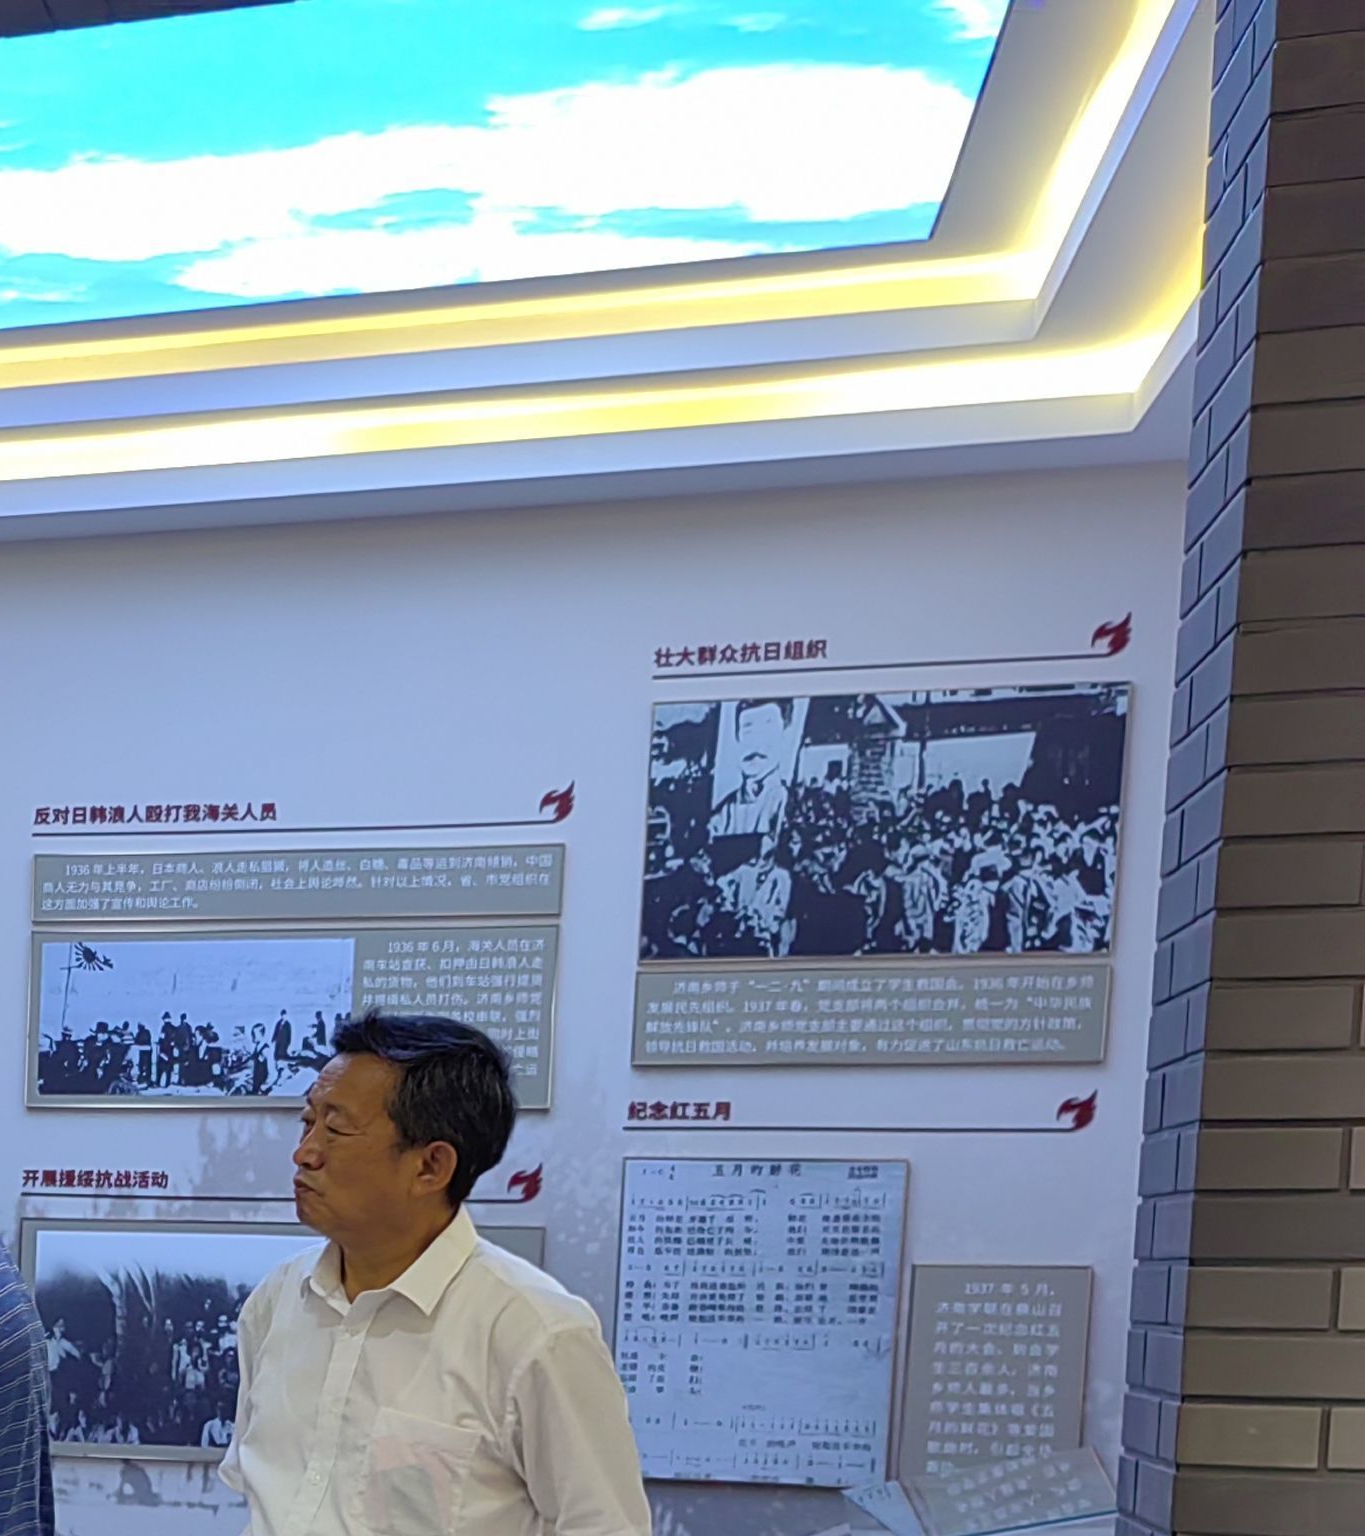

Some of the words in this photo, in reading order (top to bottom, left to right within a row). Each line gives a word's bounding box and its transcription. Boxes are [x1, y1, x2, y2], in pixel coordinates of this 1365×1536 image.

[653, 639, 828, 668] 壮大群众抗日组织
[32, 802, 277, 826] 反对日韩浪人殴打我海关人员
[628, 1101, 731, 1122] 纪念红五月
[21, 1169, 169, 1191] 开展援绥抗战活动
